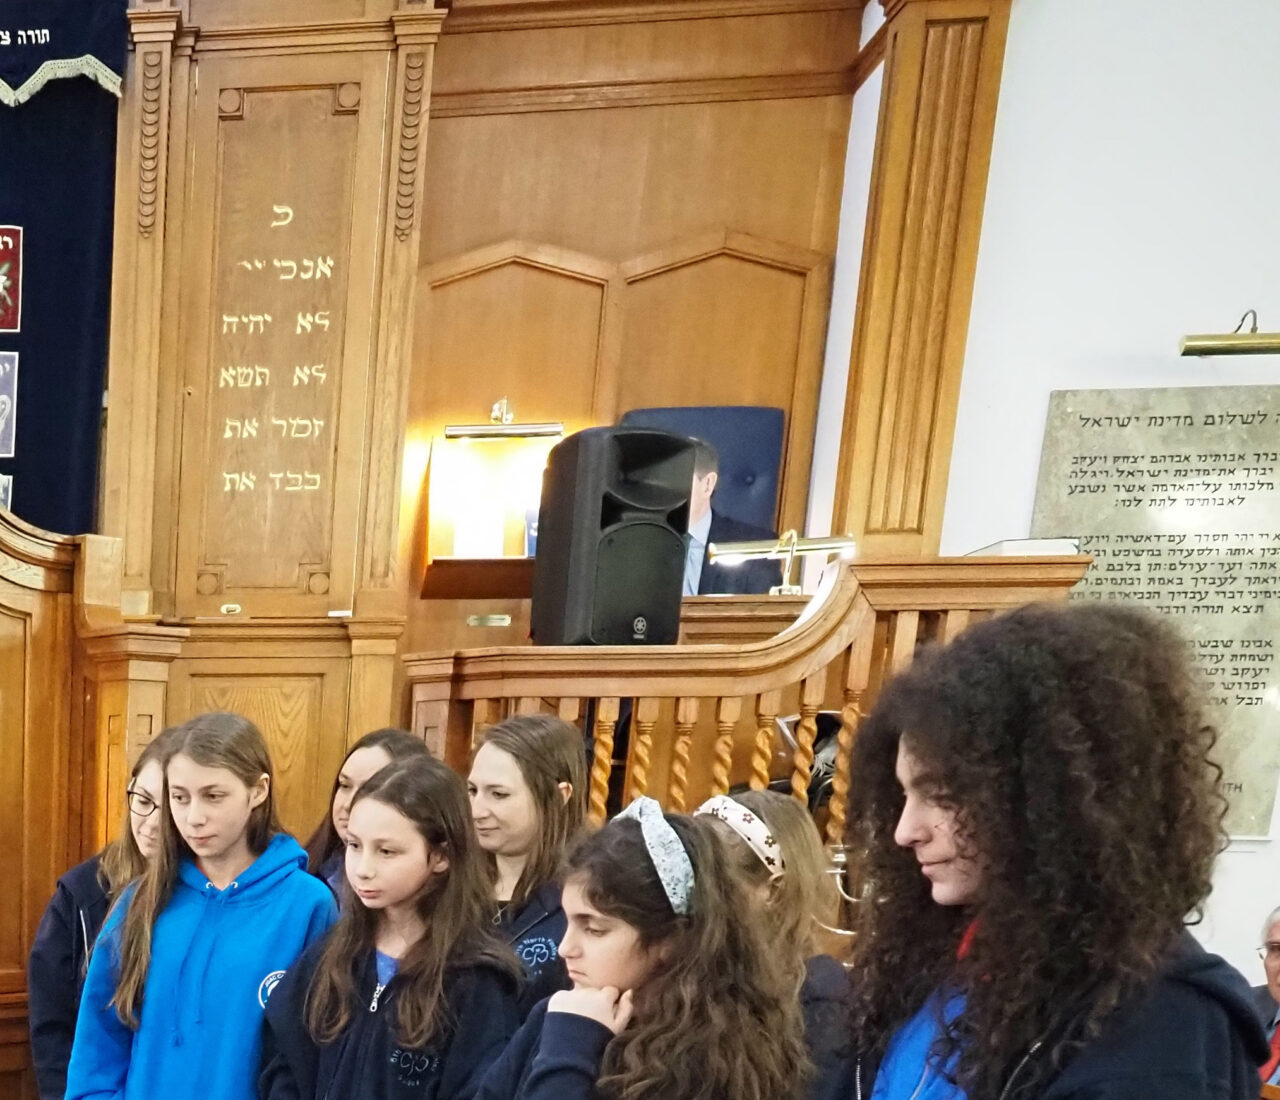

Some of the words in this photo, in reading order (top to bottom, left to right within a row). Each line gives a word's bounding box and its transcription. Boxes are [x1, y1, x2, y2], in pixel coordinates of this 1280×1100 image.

[17, 28, 50, 45] תורה
[272, 255, 334, 280] אנכי
[295, 311, 330, 335] לא
[219, 365, 270, 388] תשא
[293, 364, 327, 387] לא
[1079, 414, 1140, 428] ישראל
[1147, 414, 1194, 427] מדינת
[1204, 410, 1268, 426] לשלום
[223, 416, 259, 439] את
[1253, 452, 1280, 464] ברך
[223, 471, 256, 491] את
[1242, 467, 1274, 478] יברך
